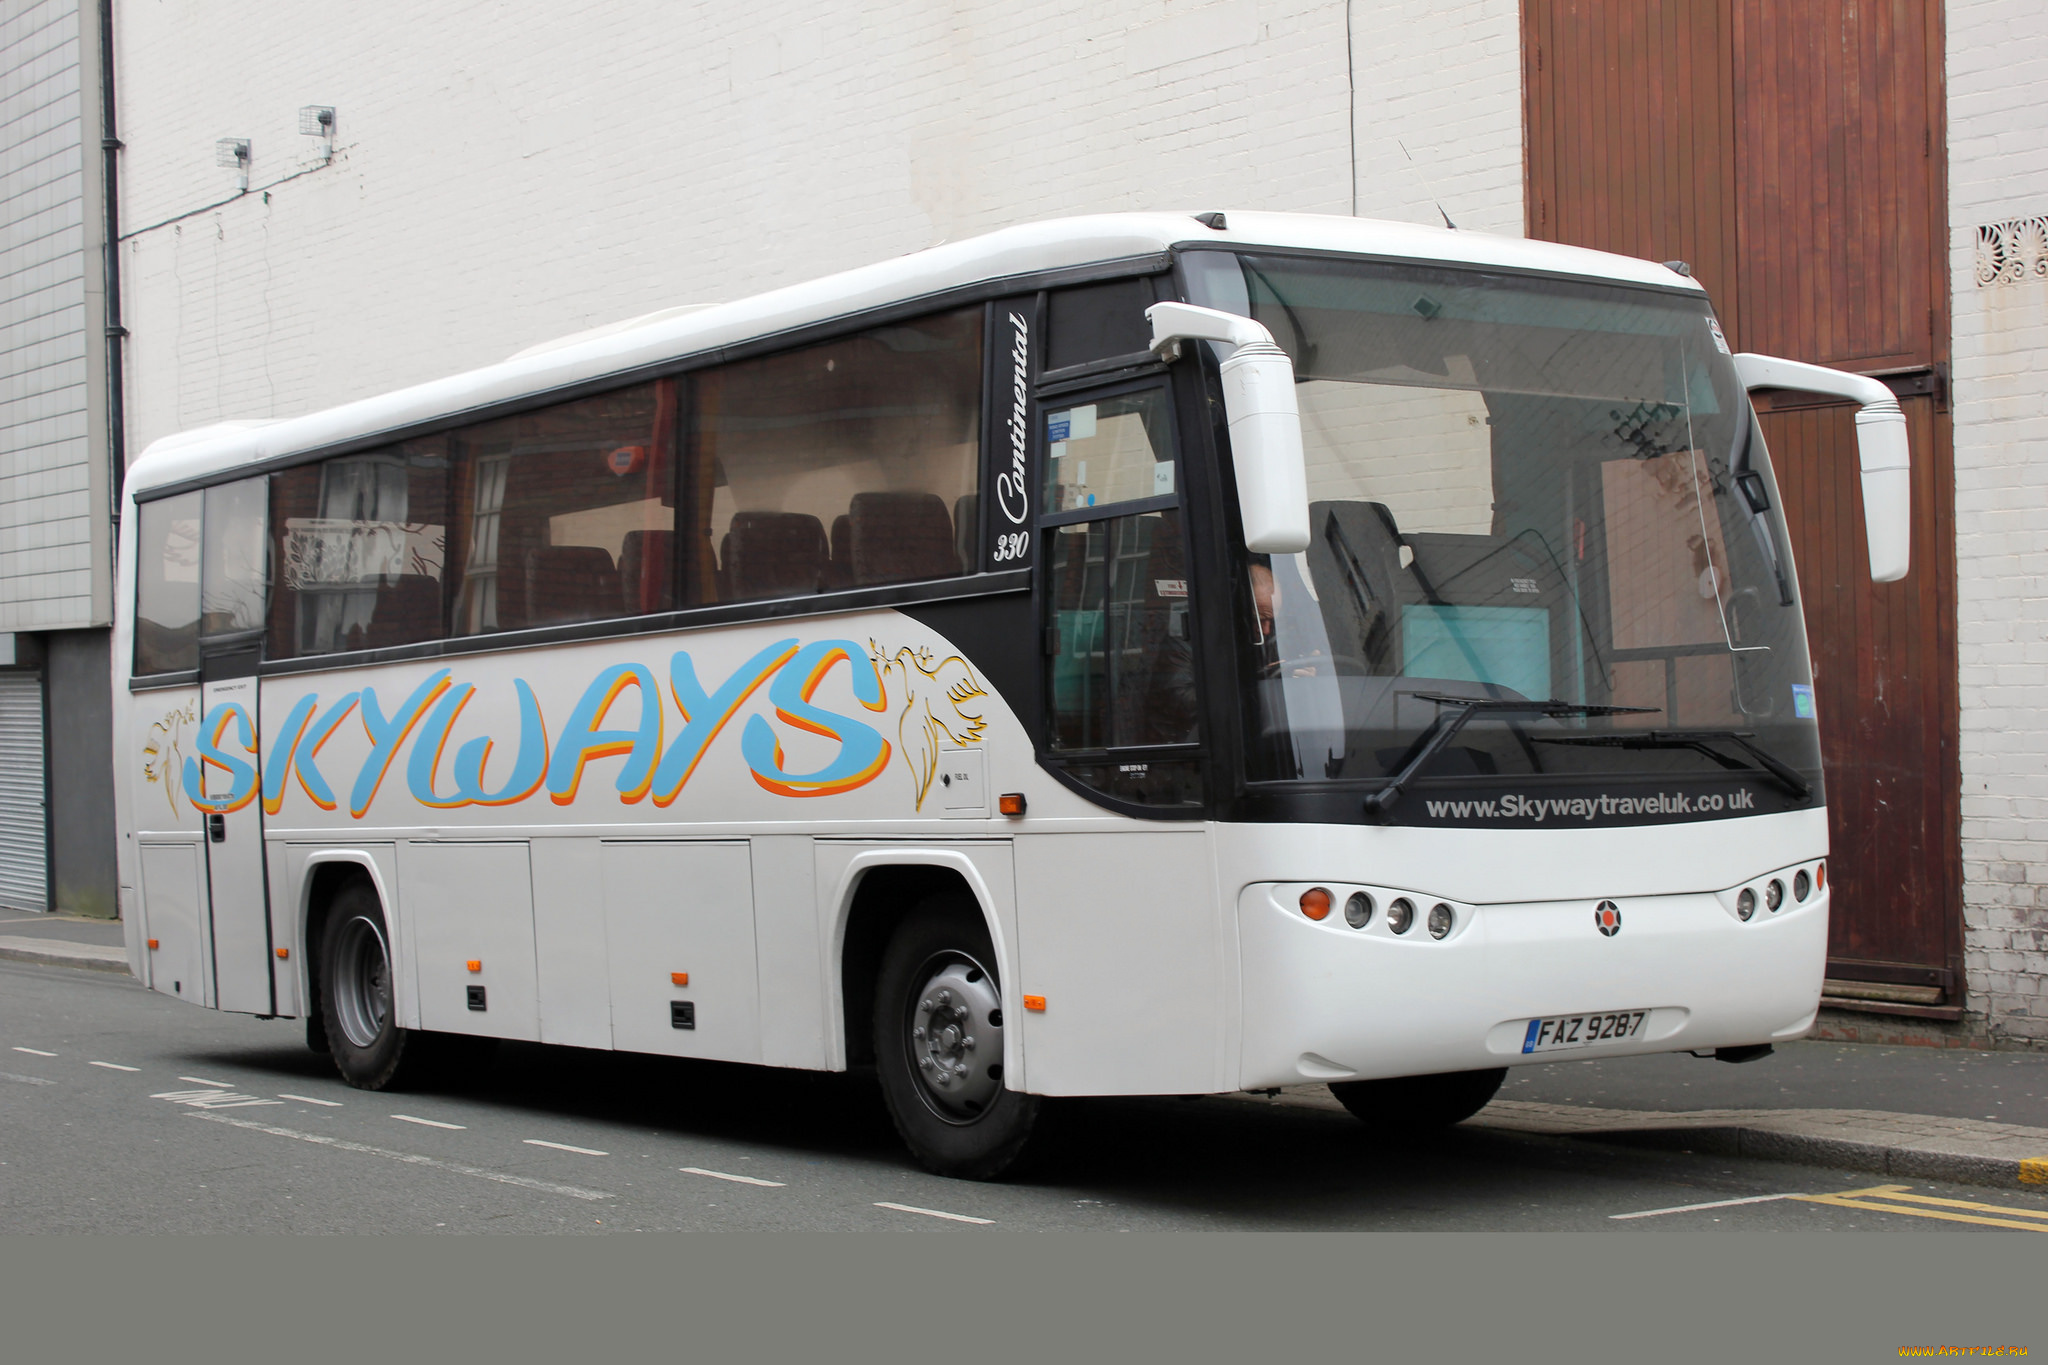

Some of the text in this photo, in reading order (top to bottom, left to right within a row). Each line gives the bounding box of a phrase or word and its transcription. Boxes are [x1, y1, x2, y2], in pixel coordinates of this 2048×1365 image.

[996, 311, 1029, 525] Continental
[993, 530, 1030, 562] 330
[183, 637, 892, 819] SKYWAYS
[1426, 788, 1755, 822] www.Skywaytraveluk.co uk
[1537, 1017, 1584, 1046] FAZ
[1586, 1012, 1646, 1041] 9287
